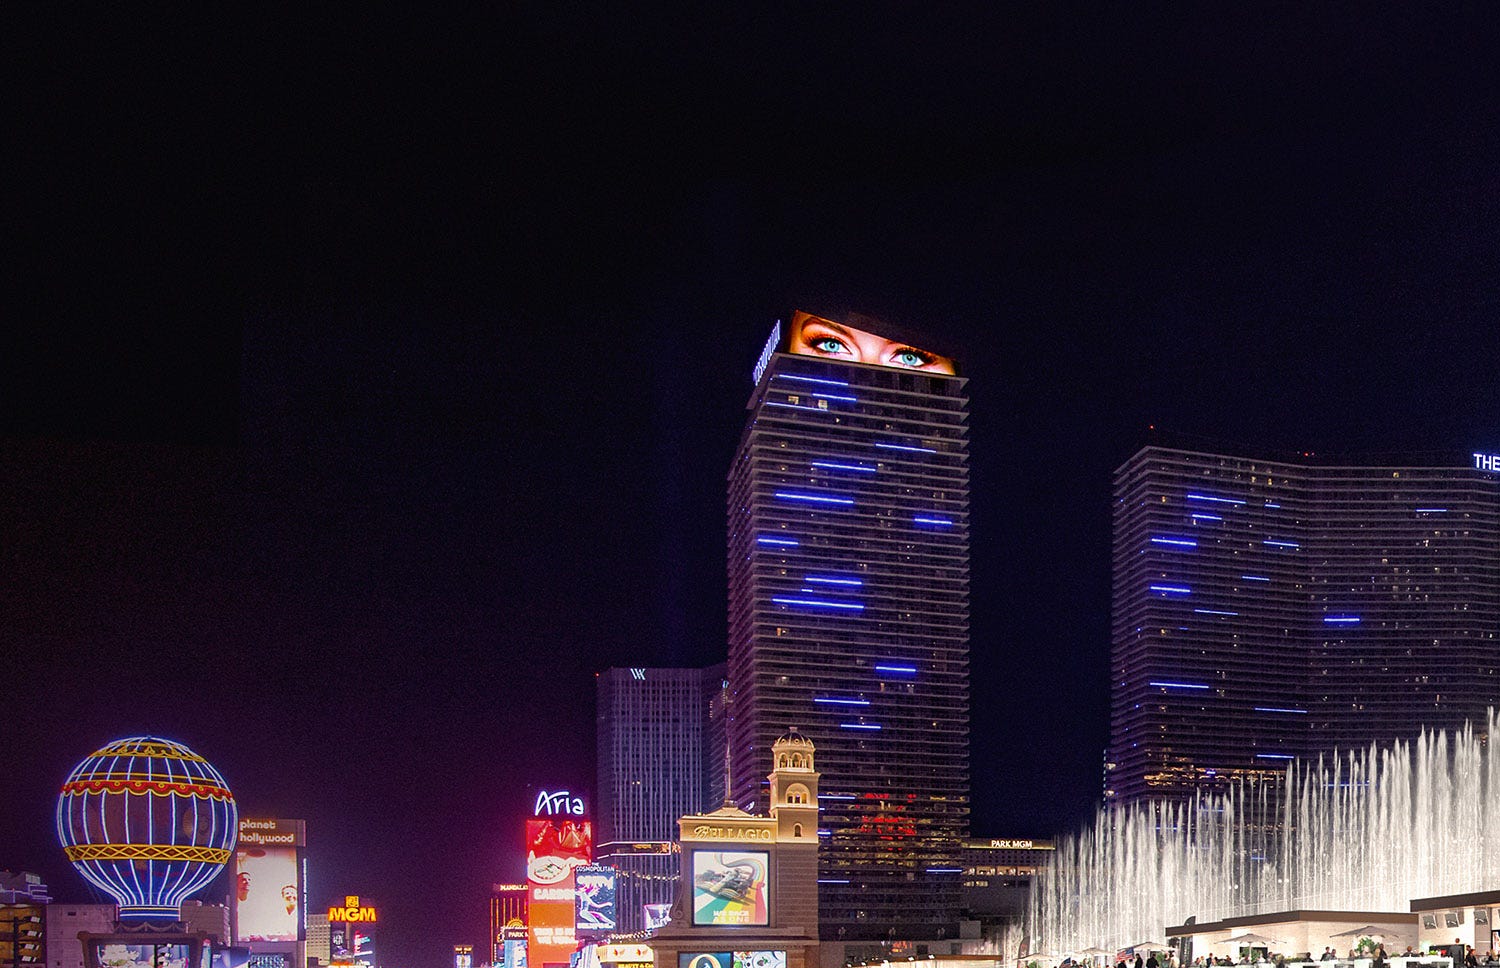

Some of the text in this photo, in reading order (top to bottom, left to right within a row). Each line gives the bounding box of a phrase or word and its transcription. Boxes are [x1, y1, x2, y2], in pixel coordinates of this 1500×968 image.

[1473, 453, 1500, 472] THE
[534, 790, 585, 816] Aria
[239, 820, 276, 831] planet
[694, 825, 772, 840] BELLAGIO
[239, 833, 295, 846] hollywood
[991, 840, 1033, 849] PARK MGM
[327, 907, 377, 922] MGM
